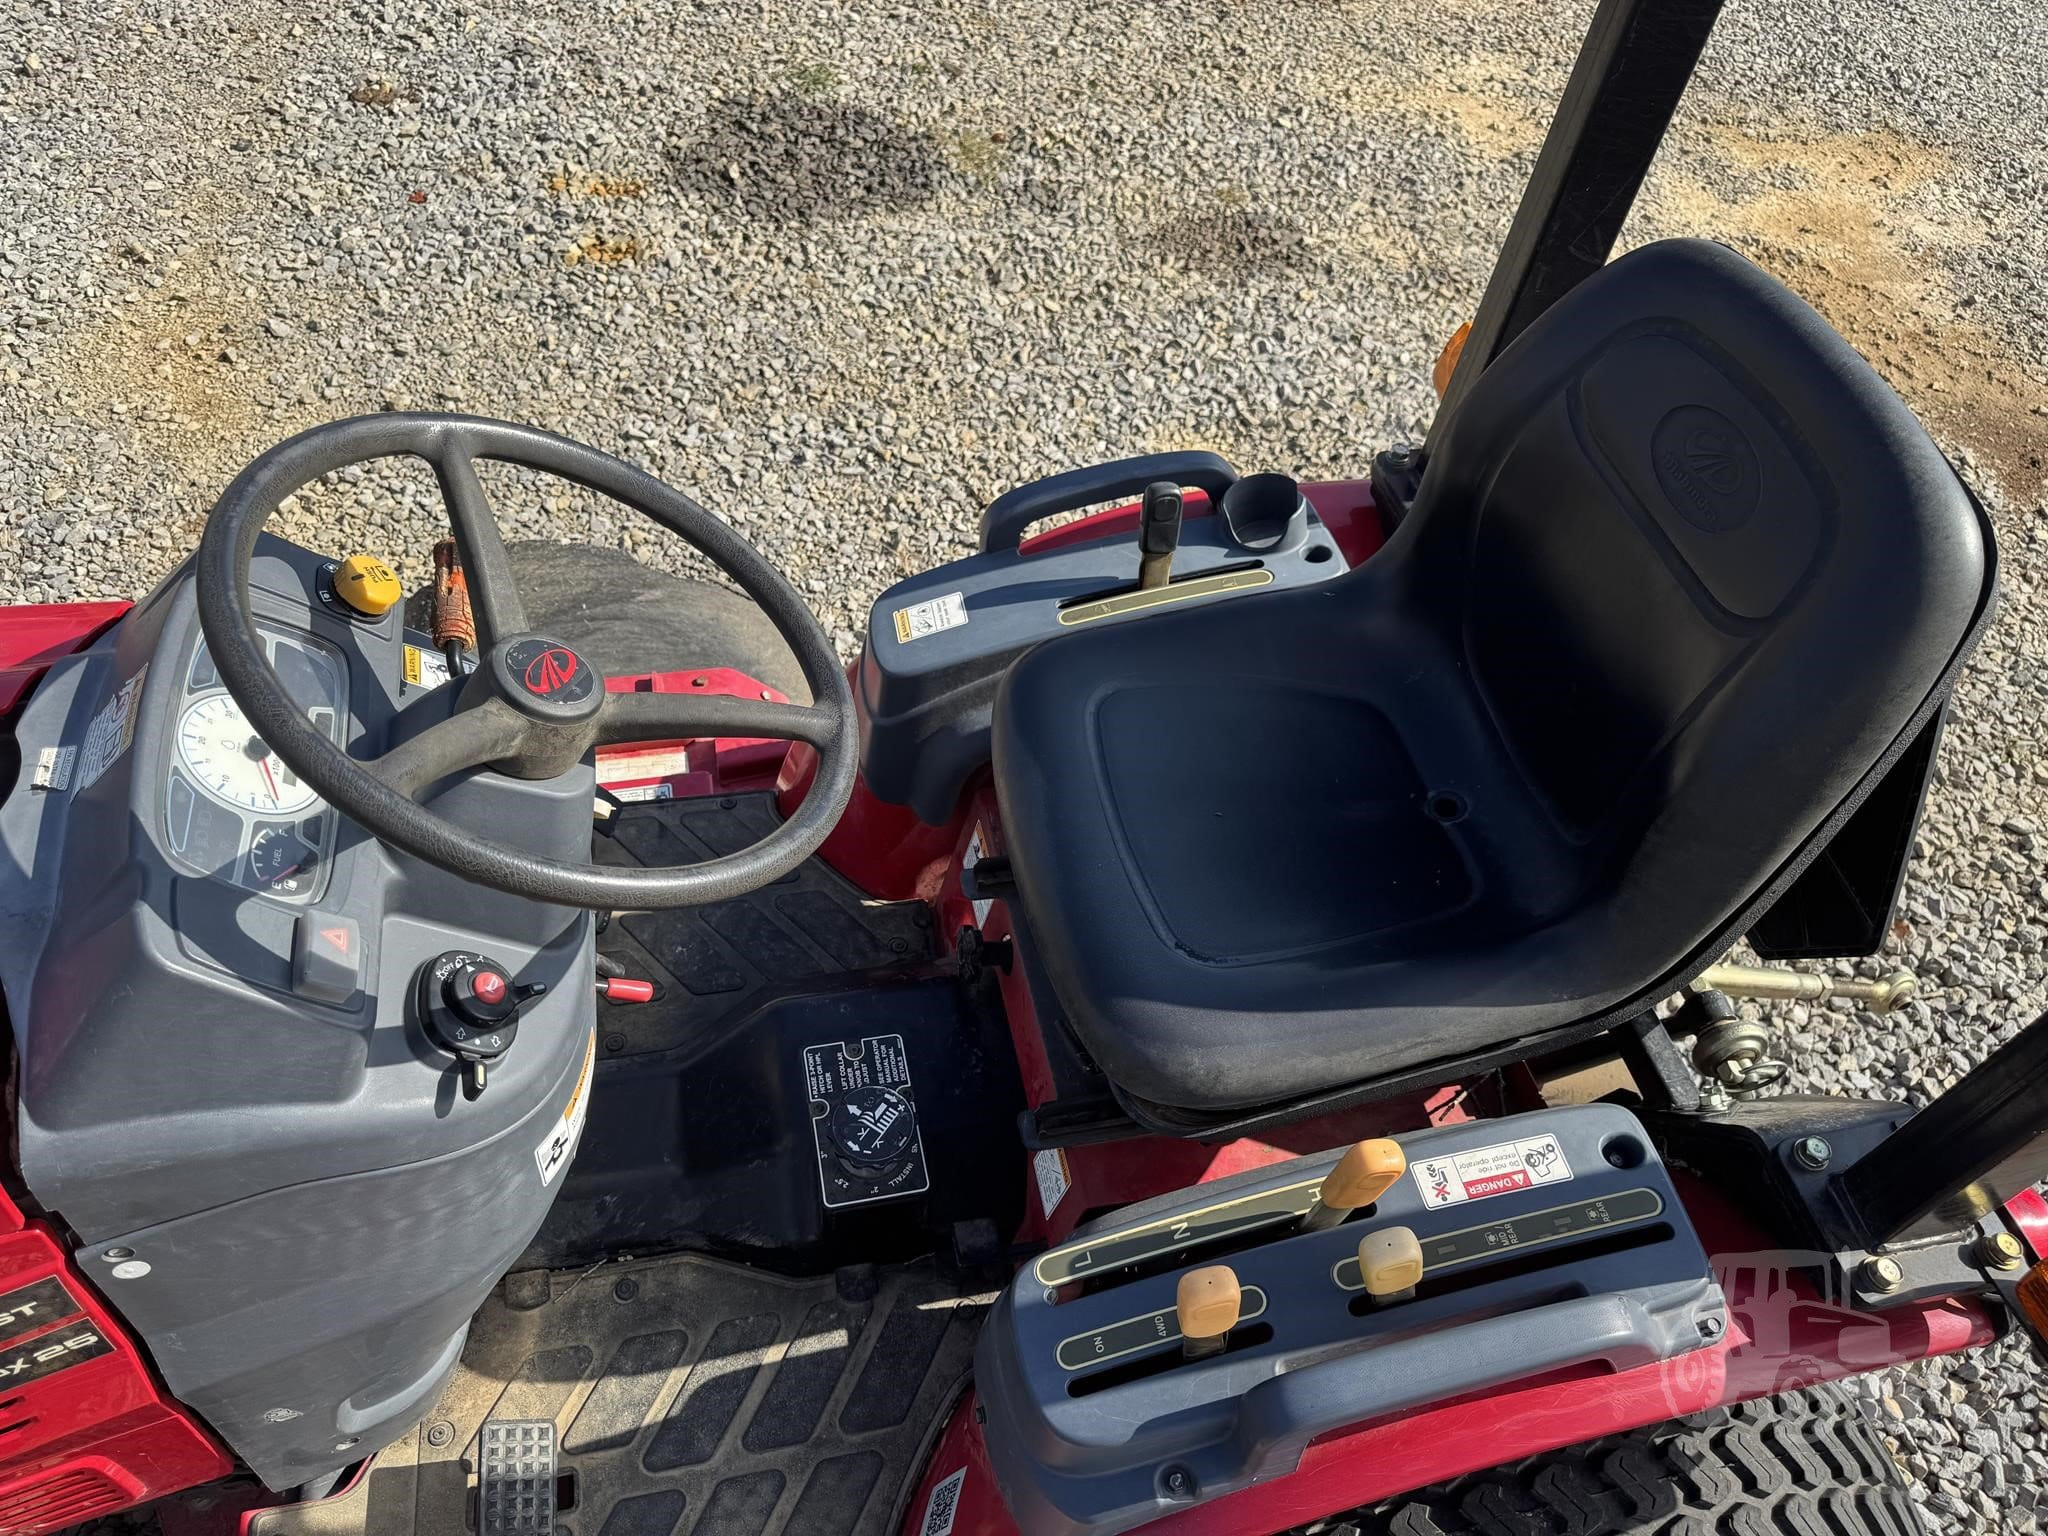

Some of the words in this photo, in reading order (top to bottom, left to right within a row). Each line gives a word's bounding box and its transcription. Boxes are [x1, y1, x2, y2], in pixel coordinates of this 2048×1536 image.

[364, 566, 378, 583] PUSH
[408, 648, 417, 674] WARNING
[198, 736, 206, 745] 20
[222, 774, 230, 783] 10
[279, 828, 288, 837] F
[273, 848, 282, 867] FUEL
[272, 880, 281, 889] E
[837, 1052, 846, 1077] COLLAR
[872, 1040, 882, 1071] OPERATOR
[888, 1047, 899, 1081] ADDITIONAL
[883, 1058, 892, 1083] MANUAL
[897, 1057, 906, 1081] DETAILS
[818, 1075, 826, 1094] HITCH
[825, 1072, 833, 1092] LEVER
[1459, 1158, 1490, 1170] operator
[1491, 1153, 1516, 1164] except
[1495, 1162, 1507, 1170] not
[888, 1162, 914, 1187] INSTALL
[1478, 1166, 1492, 1174] ride
[1469, 1179, 1512, 1194] DANGER
[1596, 1201, 1611, 1222] REAR
[1170, 1221, 1191, 1240] N
[1504, 1222, 1519, 1244] REAR
[1075, 1251, 1092, 1268] L
[1154, 1315, 1167, 1337] 4WD
[33, 1332, 98, 1362] 25
[1093, 1336, 1105, 1353] ON
